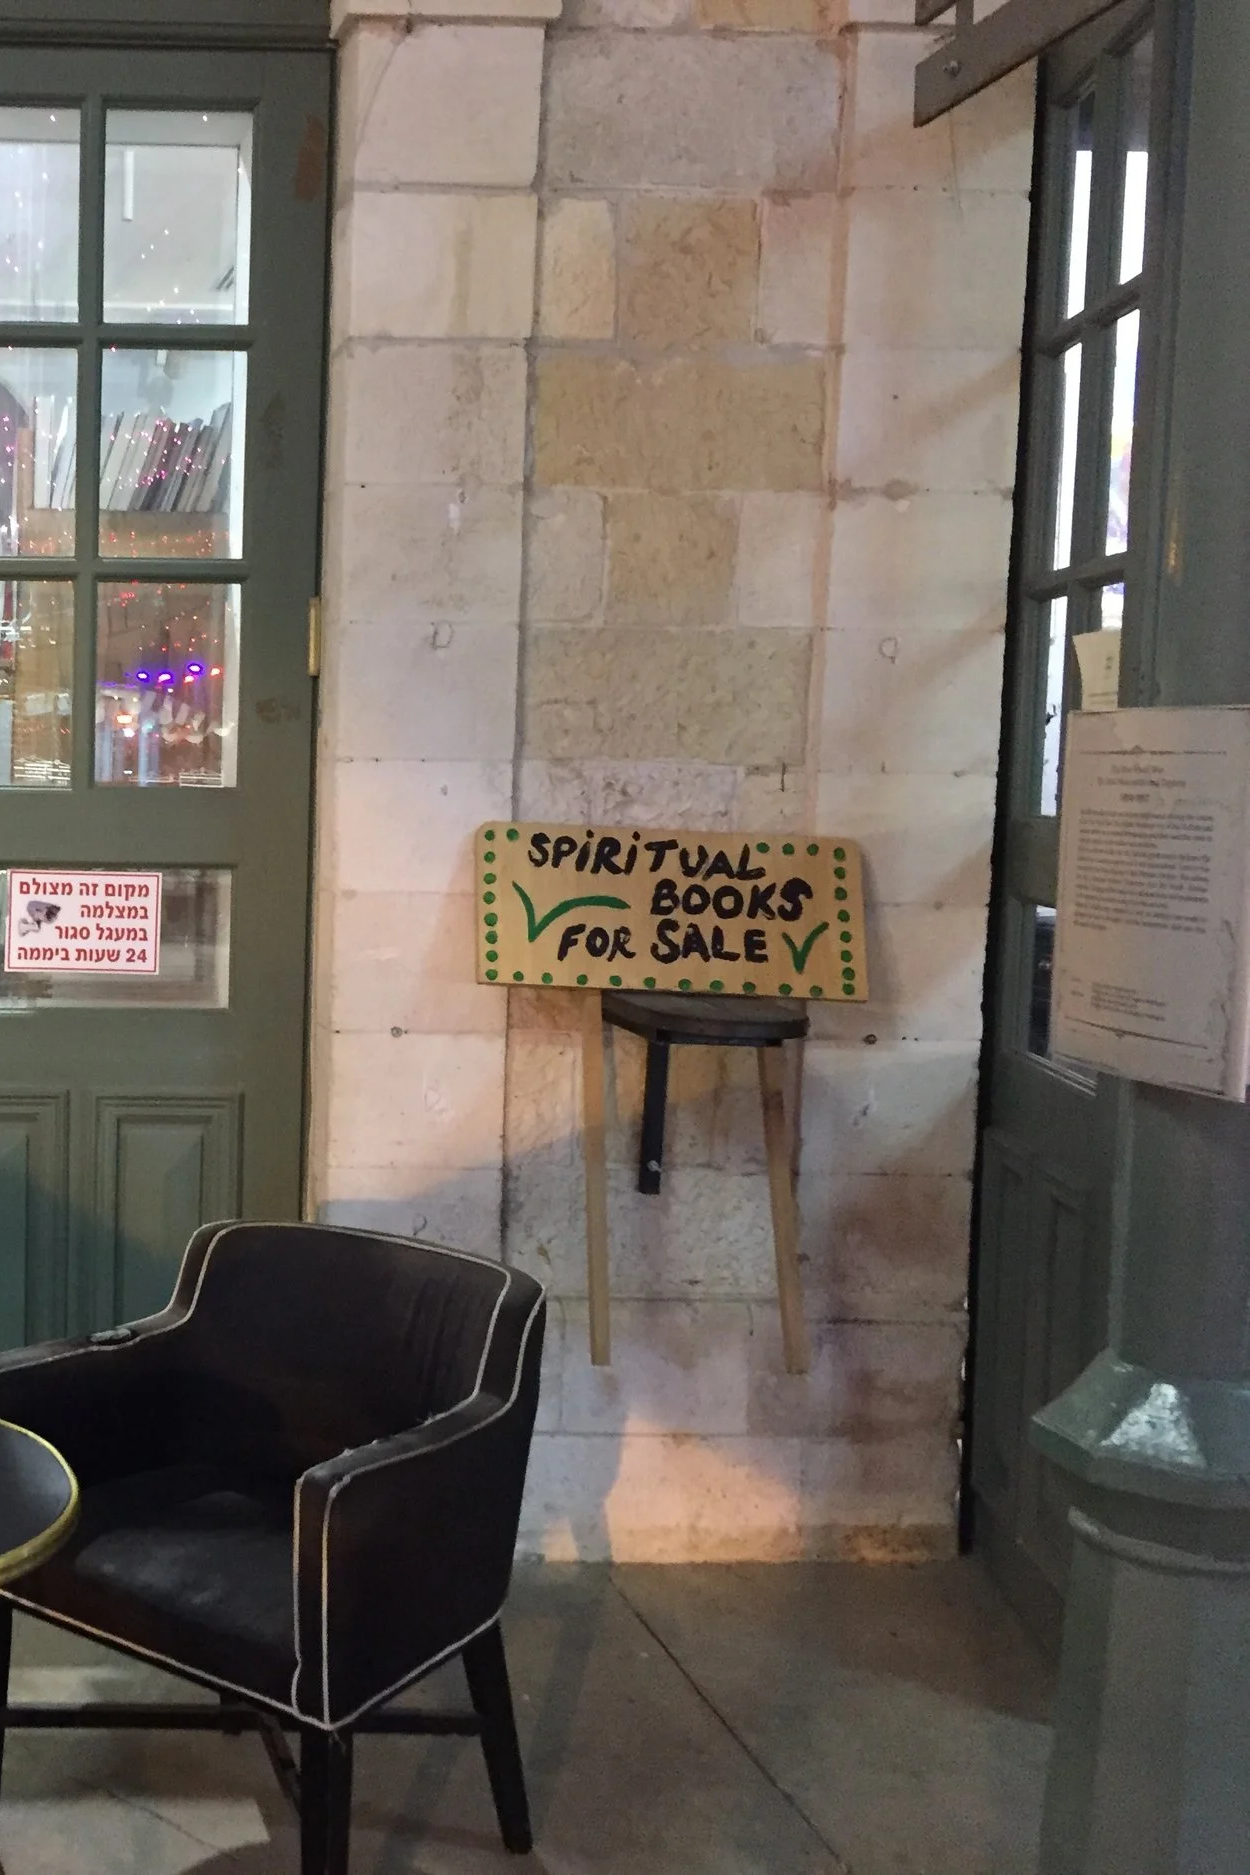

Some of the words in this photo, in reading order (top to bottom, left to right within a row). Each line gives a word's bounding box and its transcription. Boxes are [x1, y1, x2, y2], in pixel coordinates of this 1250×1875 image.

[19, 878, 73, 896] מצולם
[79, 882, 99, 897] זה
[105, 884, 150, 901] מקום
[650, 877, 813, 922] BOOKS
[80, 901, 149, 920] במצלמה
[55, 925, 91, 940] סגור
[96, 923, 148, 942] במעגל
[557, 923, 636, 962] FOR
[650, 917, 769, 964] SALE
[17, 946, 70, 961] ביממה
[75, 948, 121, 963] שעות
[126, 948, 147, 963] 24
